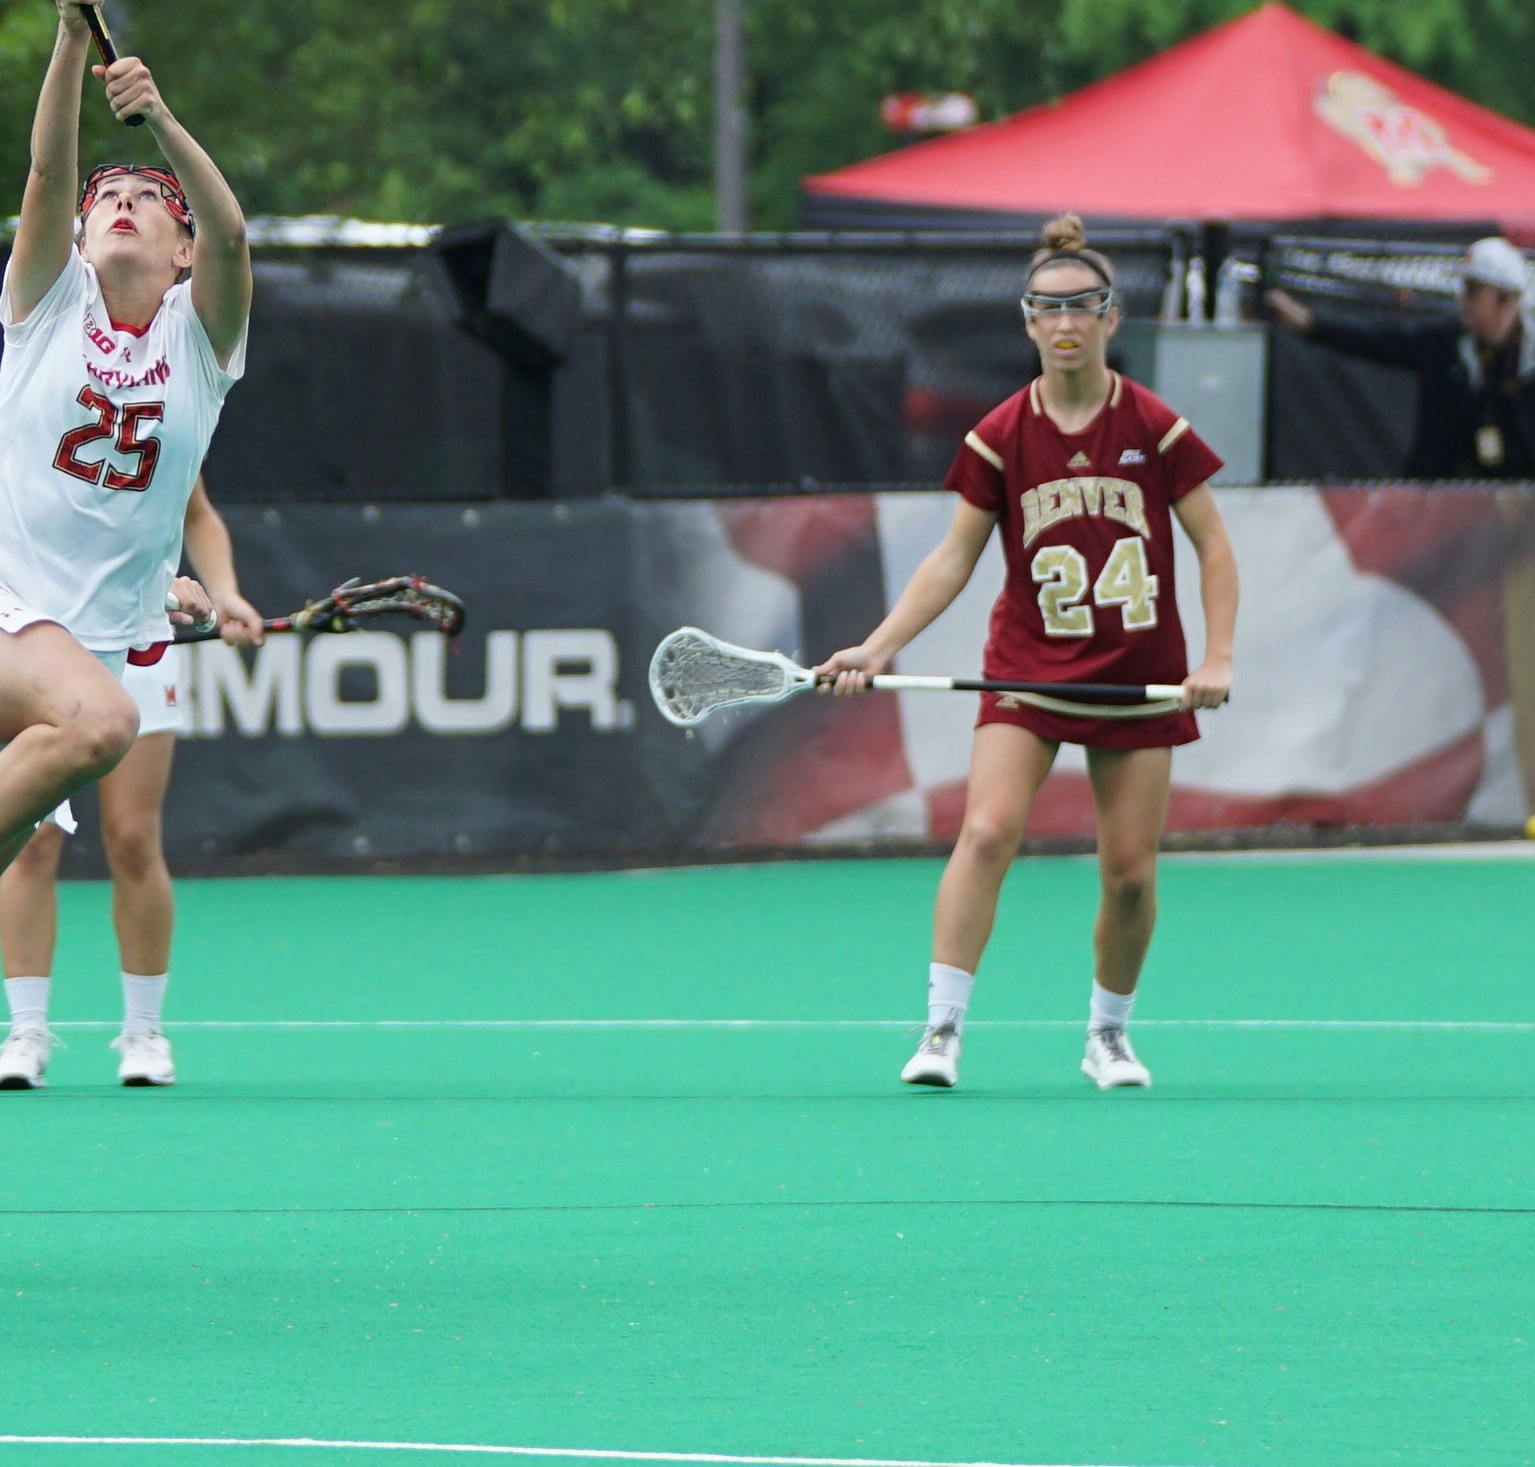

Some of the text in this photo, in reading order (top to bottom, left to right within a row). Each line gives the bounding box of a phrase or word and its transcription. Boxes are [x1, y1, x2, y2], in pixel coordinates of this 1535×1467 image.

[84, 355, 171, 390] ARYLAND
[52, 383, 166, 492] 25
[1019, 476, 1152, 550] DENVER
[1030, 536, 1159, 638] 24
[198, 625, 619, 736] MOUR
